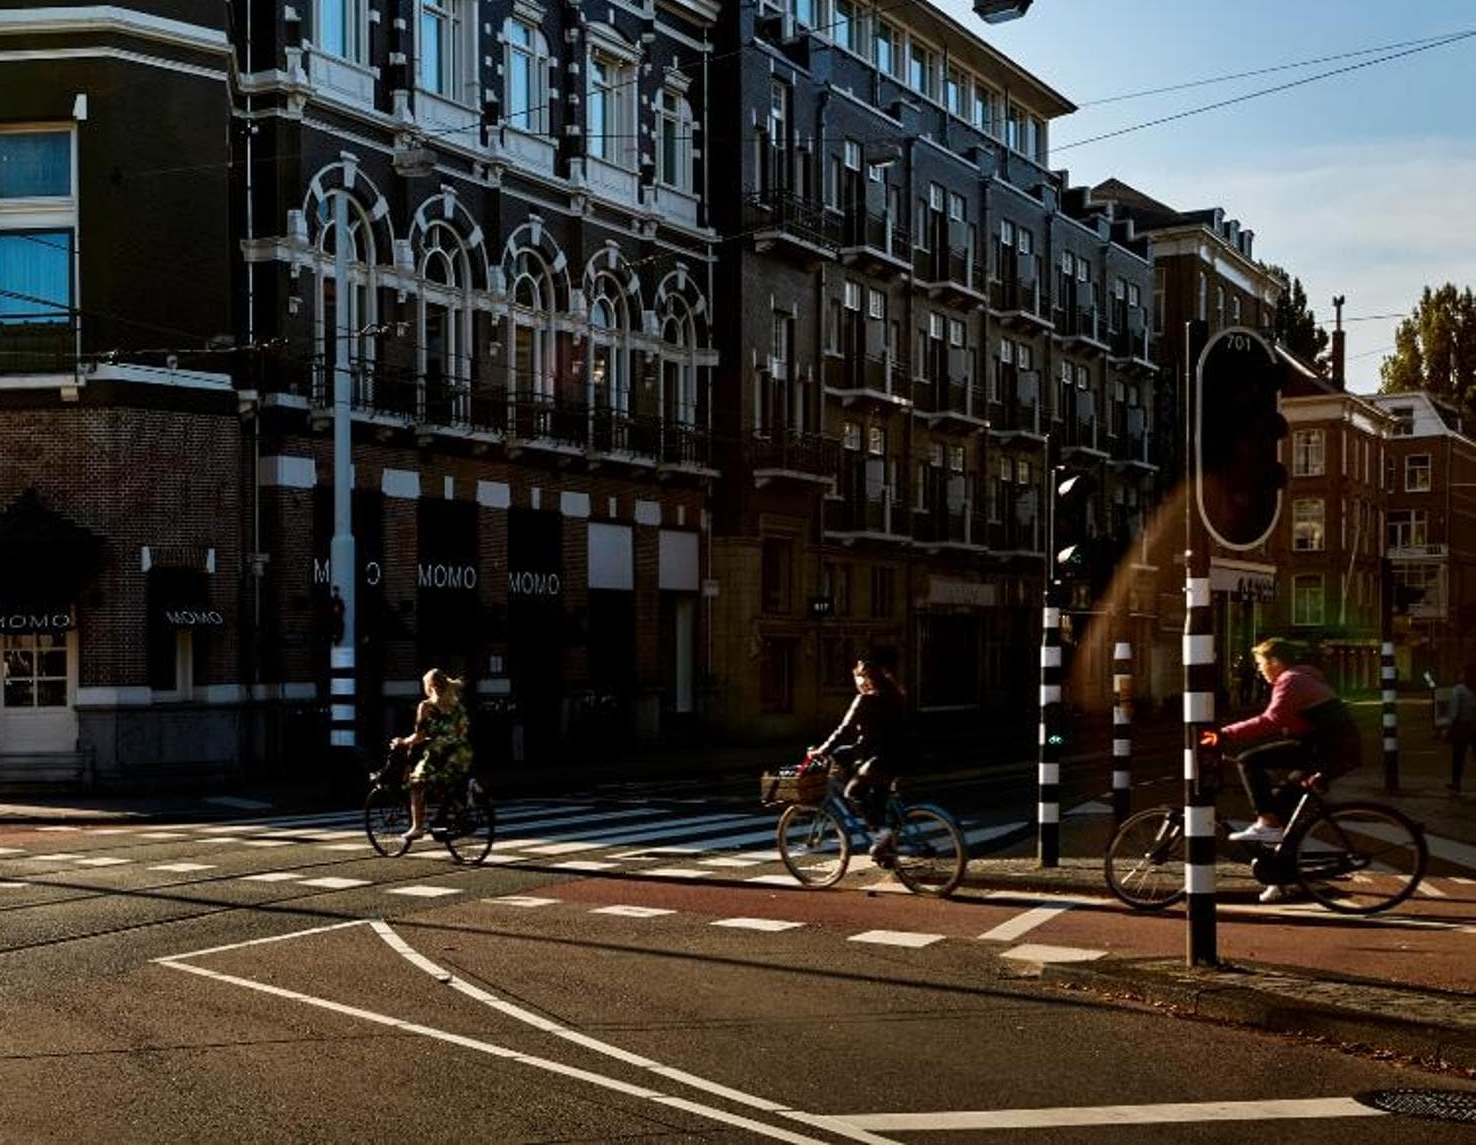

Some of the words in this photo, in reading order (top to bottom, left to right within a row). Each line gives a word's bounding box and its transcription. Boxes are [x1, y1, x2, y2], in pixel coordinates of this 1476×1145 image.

[313, 557, 381, 585] MO
[418, 562, 477, 589] MOMO
[508, 571, 560, 595] MOMO
